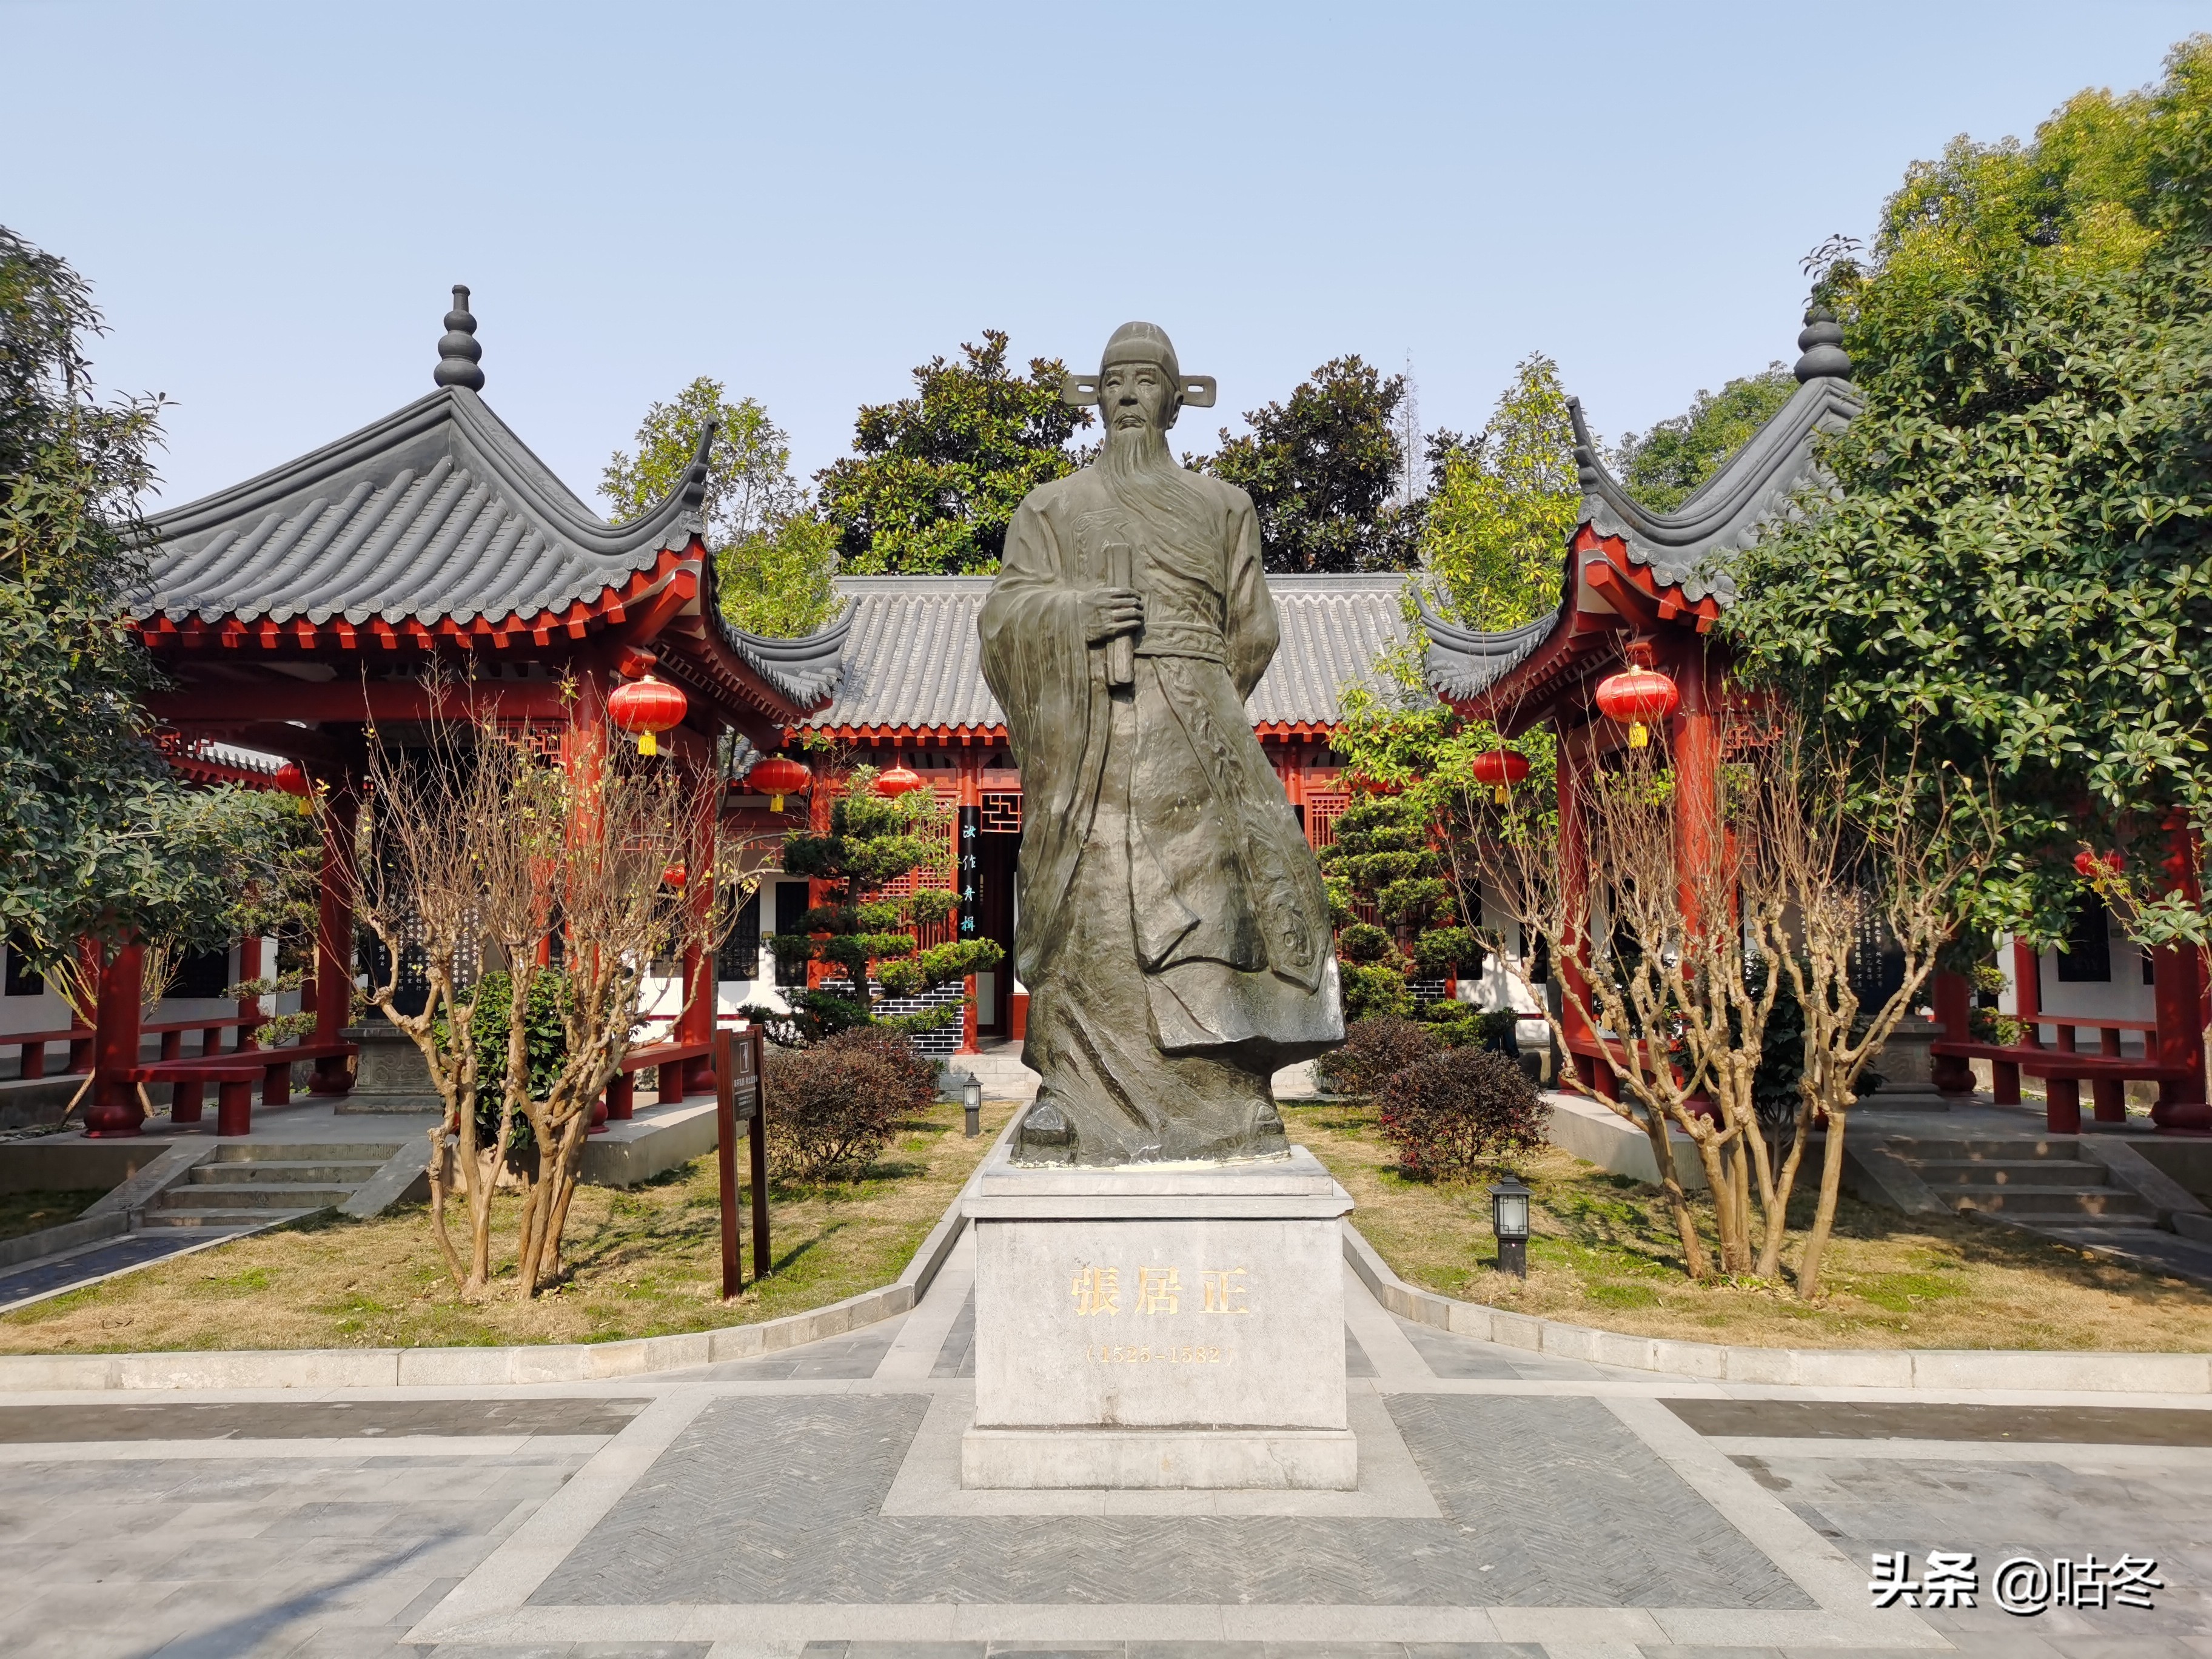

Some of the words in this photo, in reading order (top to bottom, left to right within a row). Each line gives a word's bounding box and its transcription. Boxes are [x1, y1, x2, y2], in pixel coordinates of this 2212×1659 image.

[960, 825, 976, 932] 汝作舟楫
[1069, 1265, 1250, 1317] 張居正
